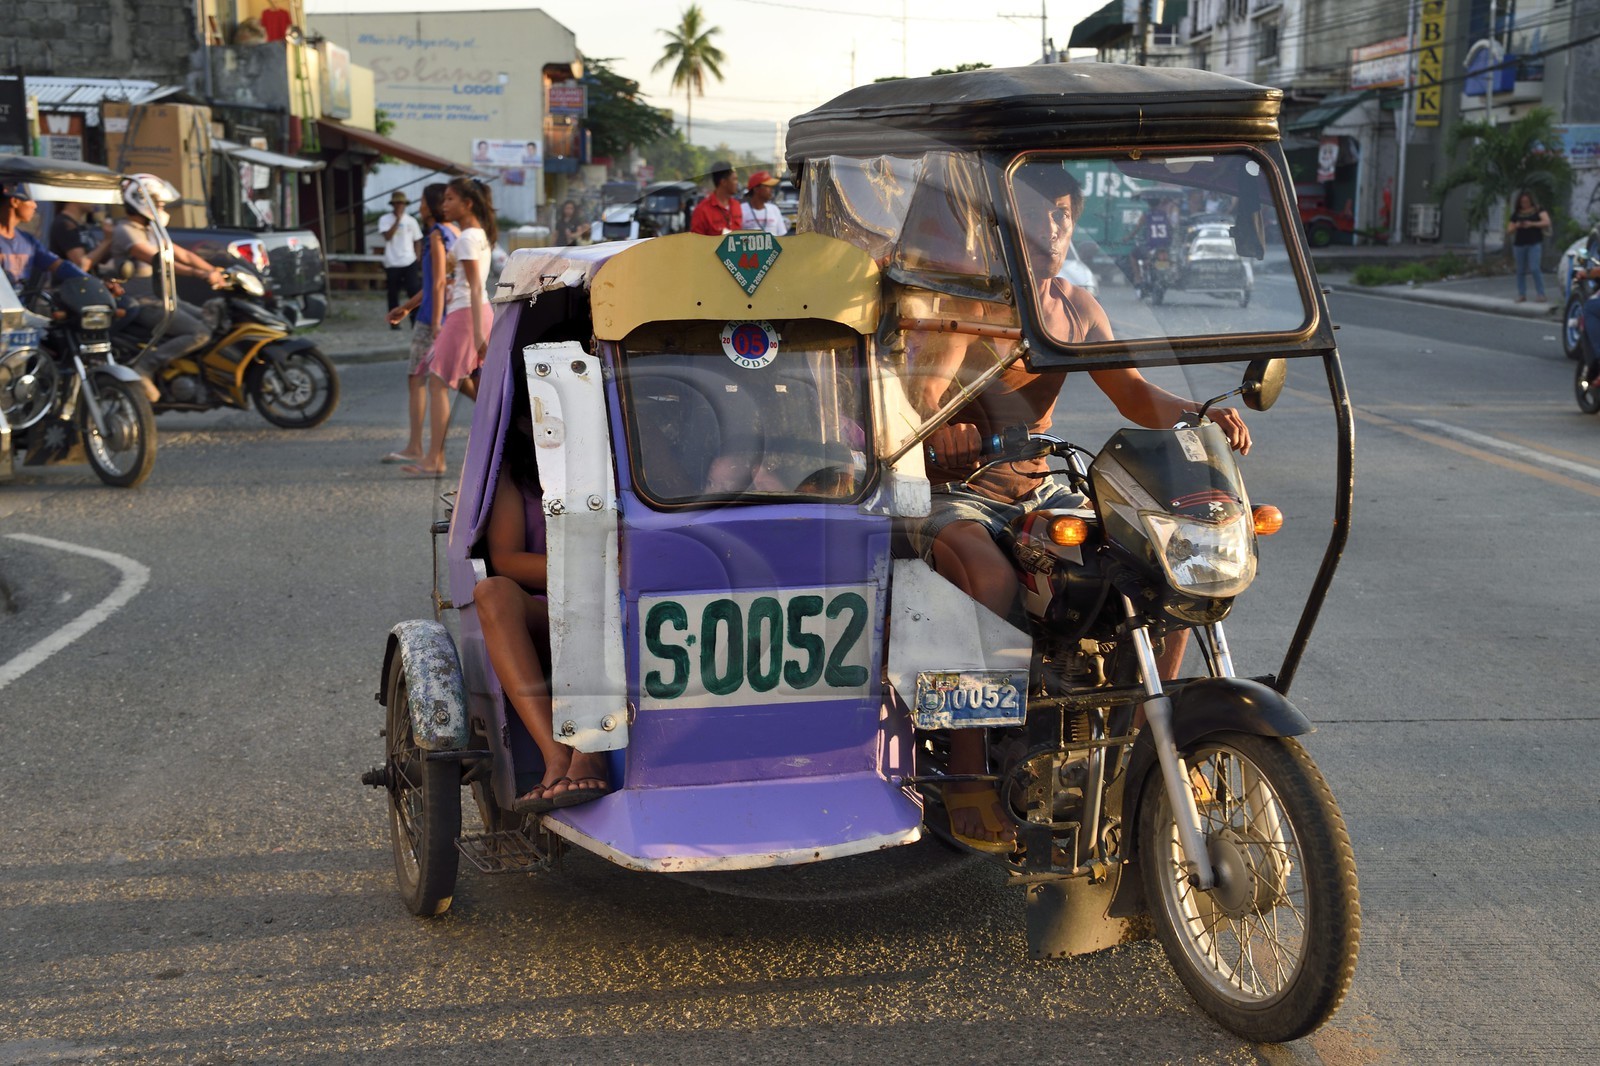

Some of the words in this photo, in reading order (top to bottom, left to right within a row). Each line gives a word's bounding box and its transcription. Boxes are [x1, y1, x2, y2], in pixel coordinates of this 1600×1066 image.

[370, 54, 493, 84] Solano
[1419, 22, 1442, 110] BANK
[453, 84, 505, 95] LODGE
[1150, 224, 1168, 239] 13
[727, 234, 773, 252] A-TODA
[738, 253, 760, 270] 44
[723, 258, 738, 274] SEC
[734, 271, 748, 287] REG
[722, 337, 731, 345] 20
[734, 332, 765, 356] 05
[769, 341, 778, 349] 00
[733, 355, 770, 368] TODA
